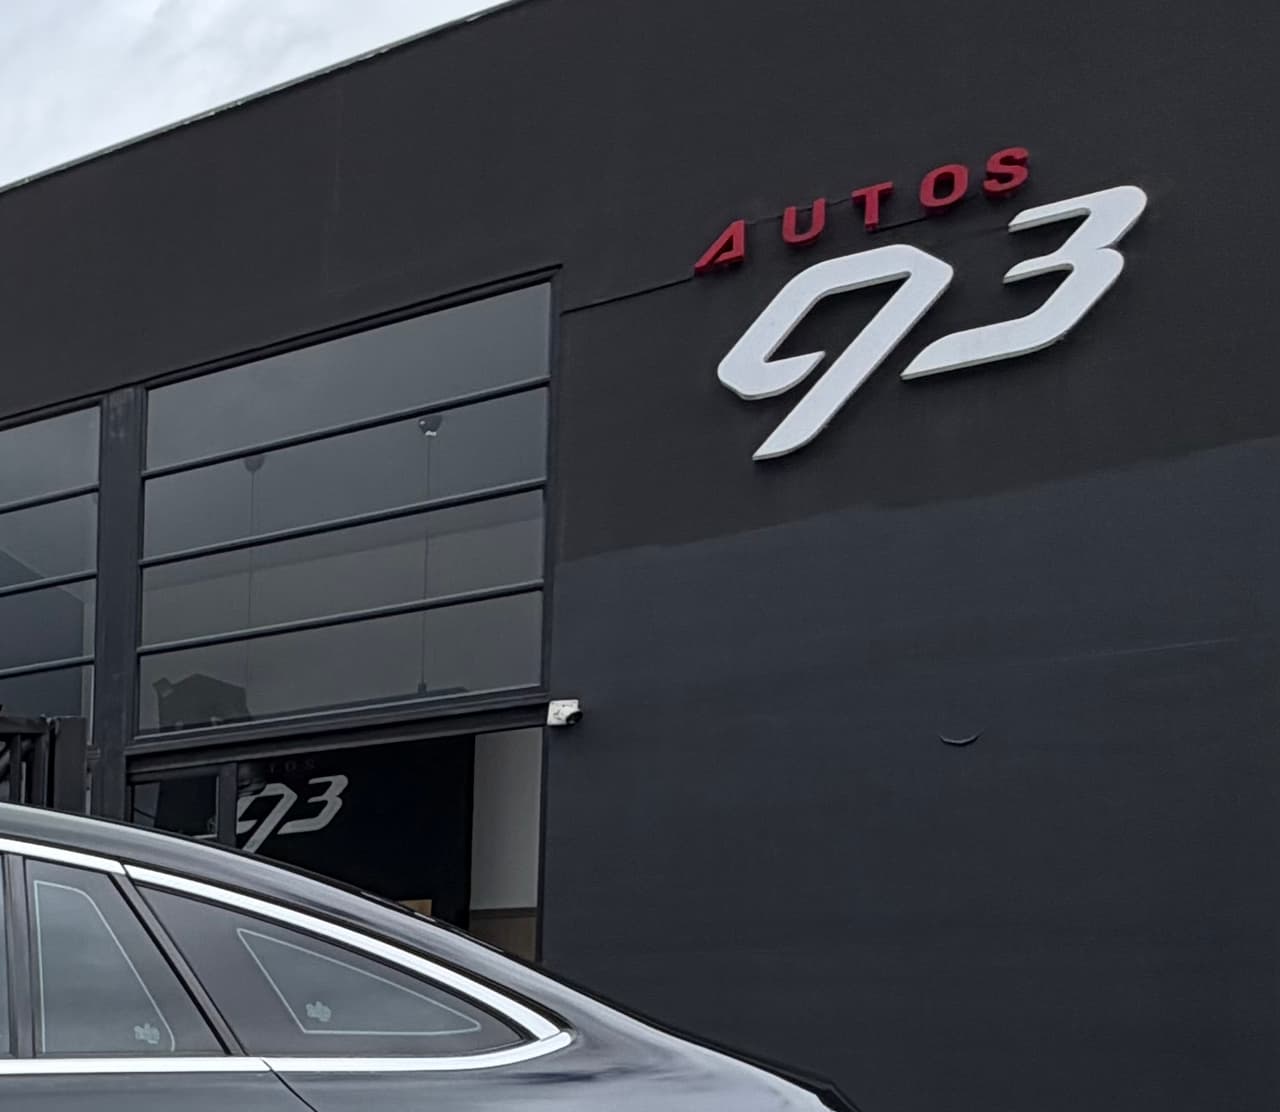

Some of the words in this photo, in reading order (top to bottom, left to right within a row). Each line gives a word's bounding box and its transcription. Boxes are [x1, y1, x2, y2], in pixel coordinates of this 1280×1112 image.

[693, 146, 1031, 277] AUTOS
[717, 185, 1148, 461] 93
[236, 774, 349, 852] 93
